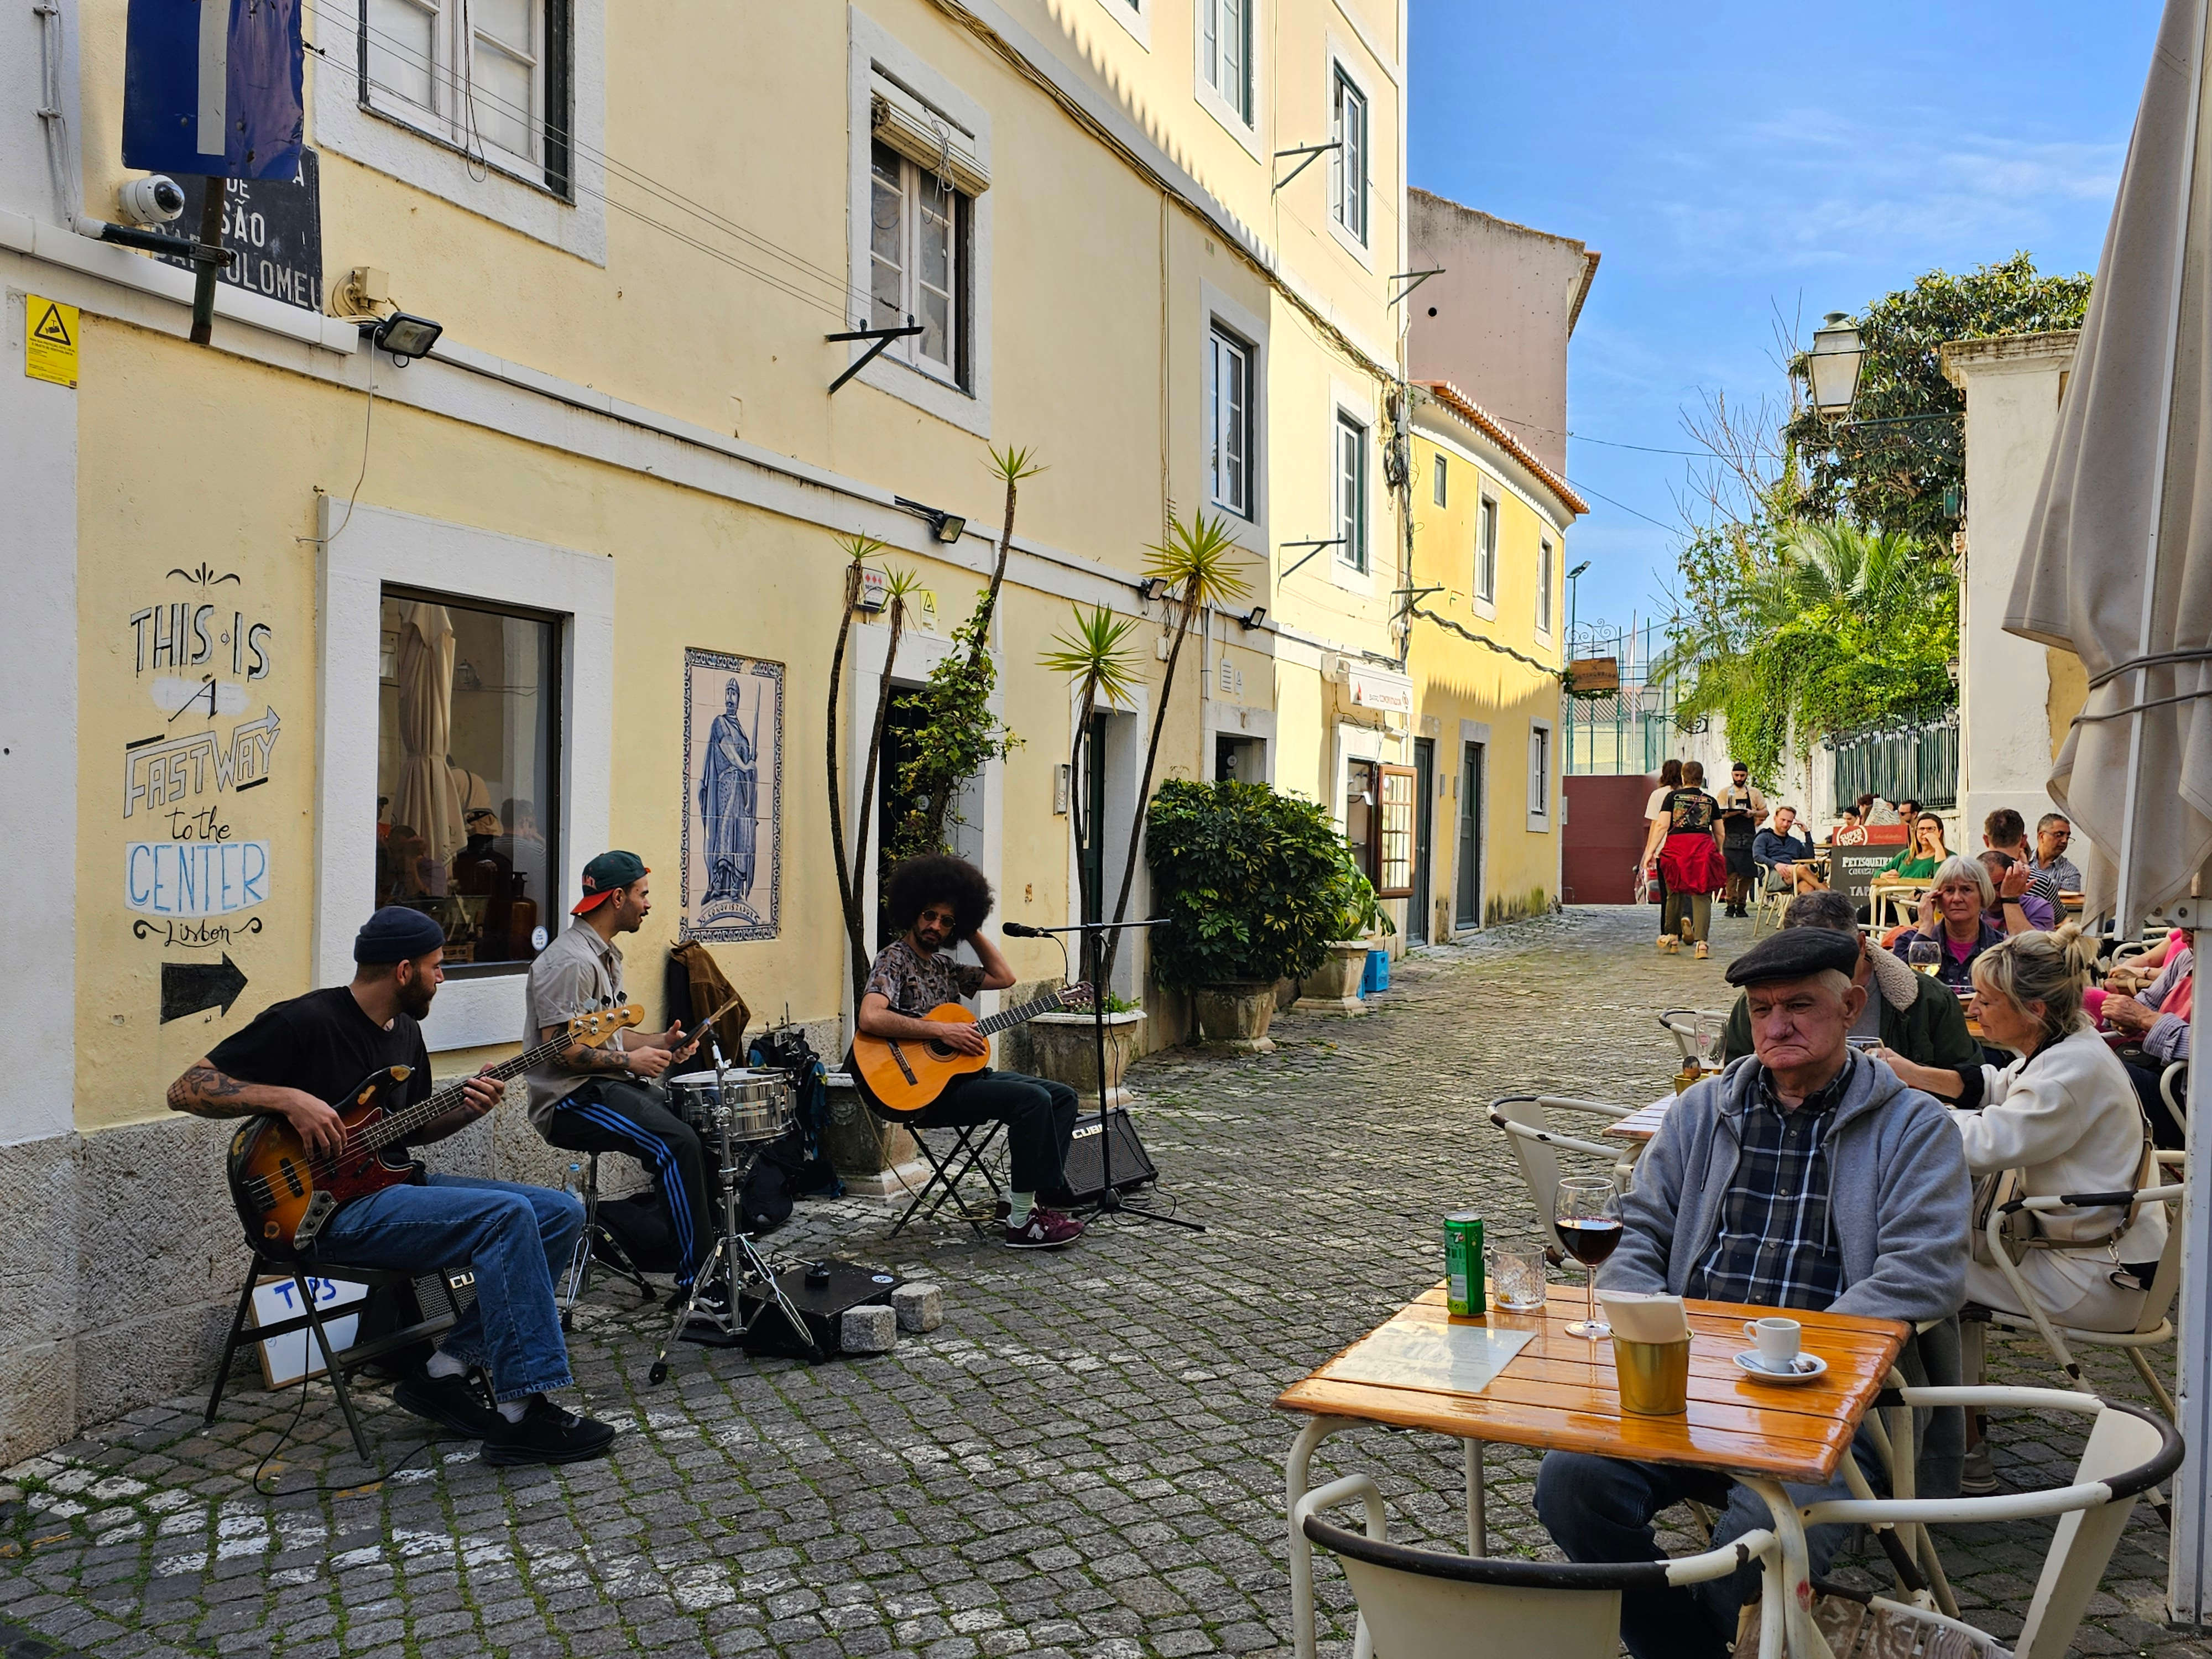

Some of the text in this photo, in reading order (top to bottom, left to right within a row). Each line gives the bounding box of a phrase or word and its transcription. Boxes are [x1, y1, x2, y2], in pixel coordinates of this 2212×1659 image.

[221, 198, 265, 248] SÃO
[131, 603, 272, 682] THIS IS
[168, 675, 218, 722] A
[164, 805, 232, 844] to the
[1840, 828, 1862, 840] SUPER
[129, 843, 265, 912] CENTER
[1849, 886, 1870, 896] TAP
[164, 919, 232, 948] Lisbon
[273, 1278, 337, 1309] TPS
[449, 1271, 475, 1289] CU
